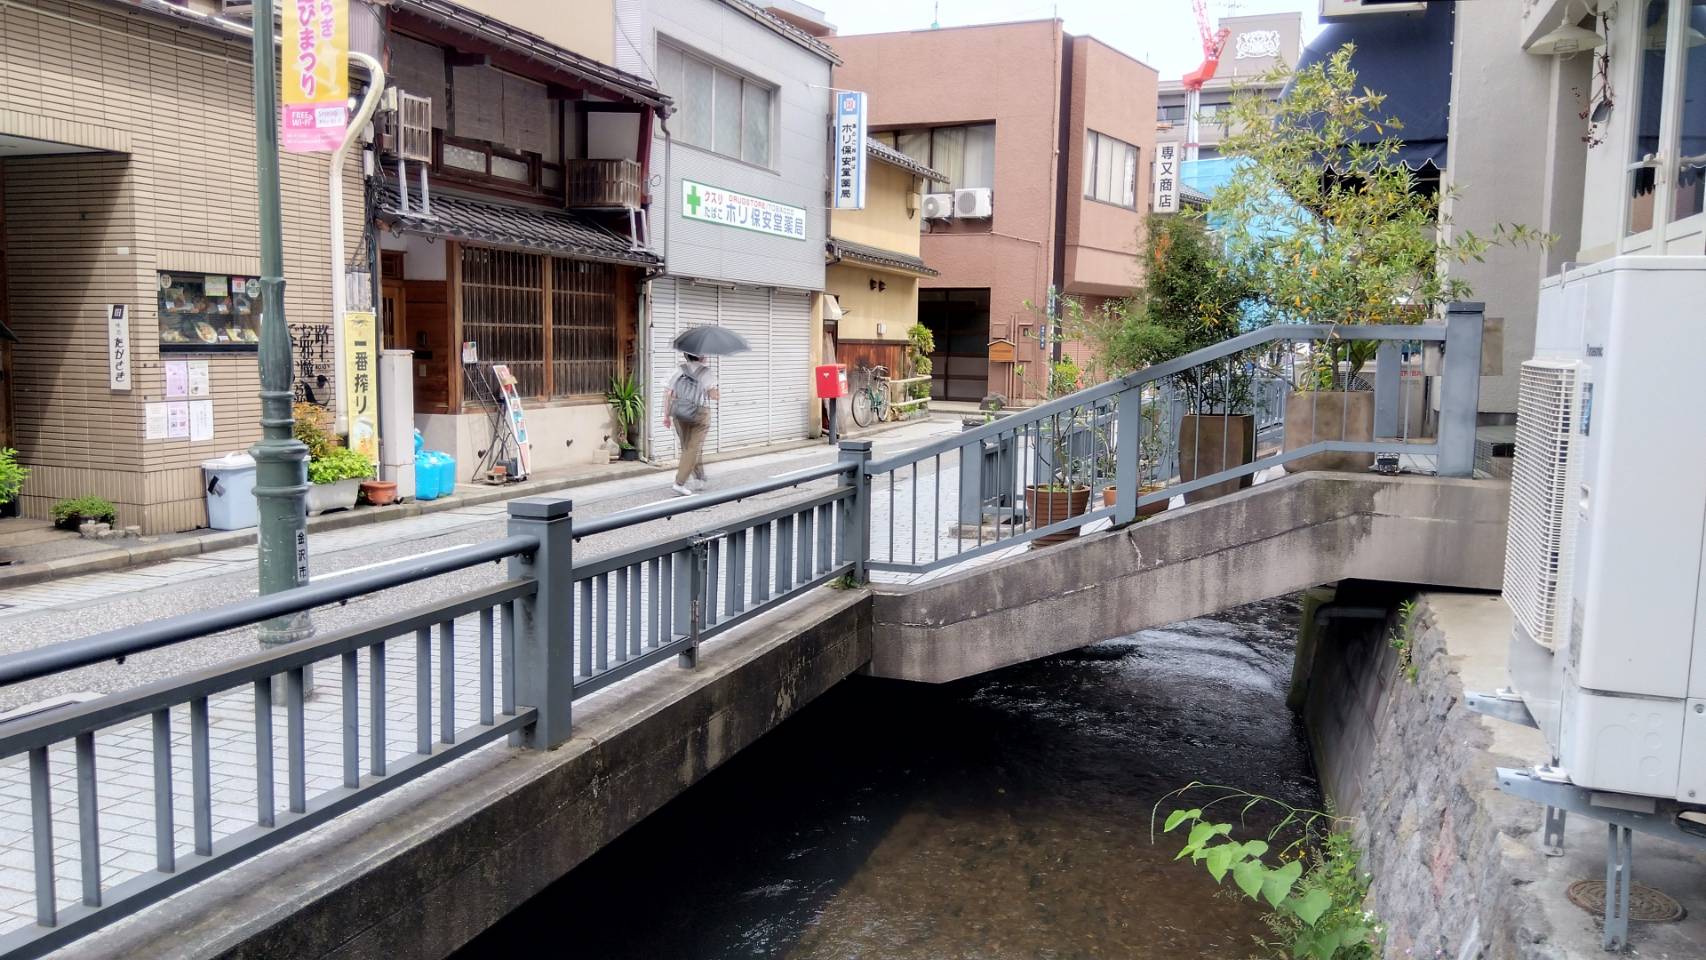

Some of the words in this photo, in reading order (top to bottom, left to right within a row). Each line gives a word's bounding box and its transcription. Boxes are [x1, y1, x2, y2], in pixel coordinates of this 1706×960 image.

[298, 0, 317, 97] びまつり
[841, 123, 852, 199] ホリ保安堂薬局
[1159, 146, 1174, 208] 専又商店
[704, 190, 723, 206] クスリ
[704, 205, 723, 220] たばこ
[726, 203, 804, 236] ホリ保安堂薬局
[354, 340, 369, 414] 一番搾り
[297, 531, 307, 579] 金沢市
